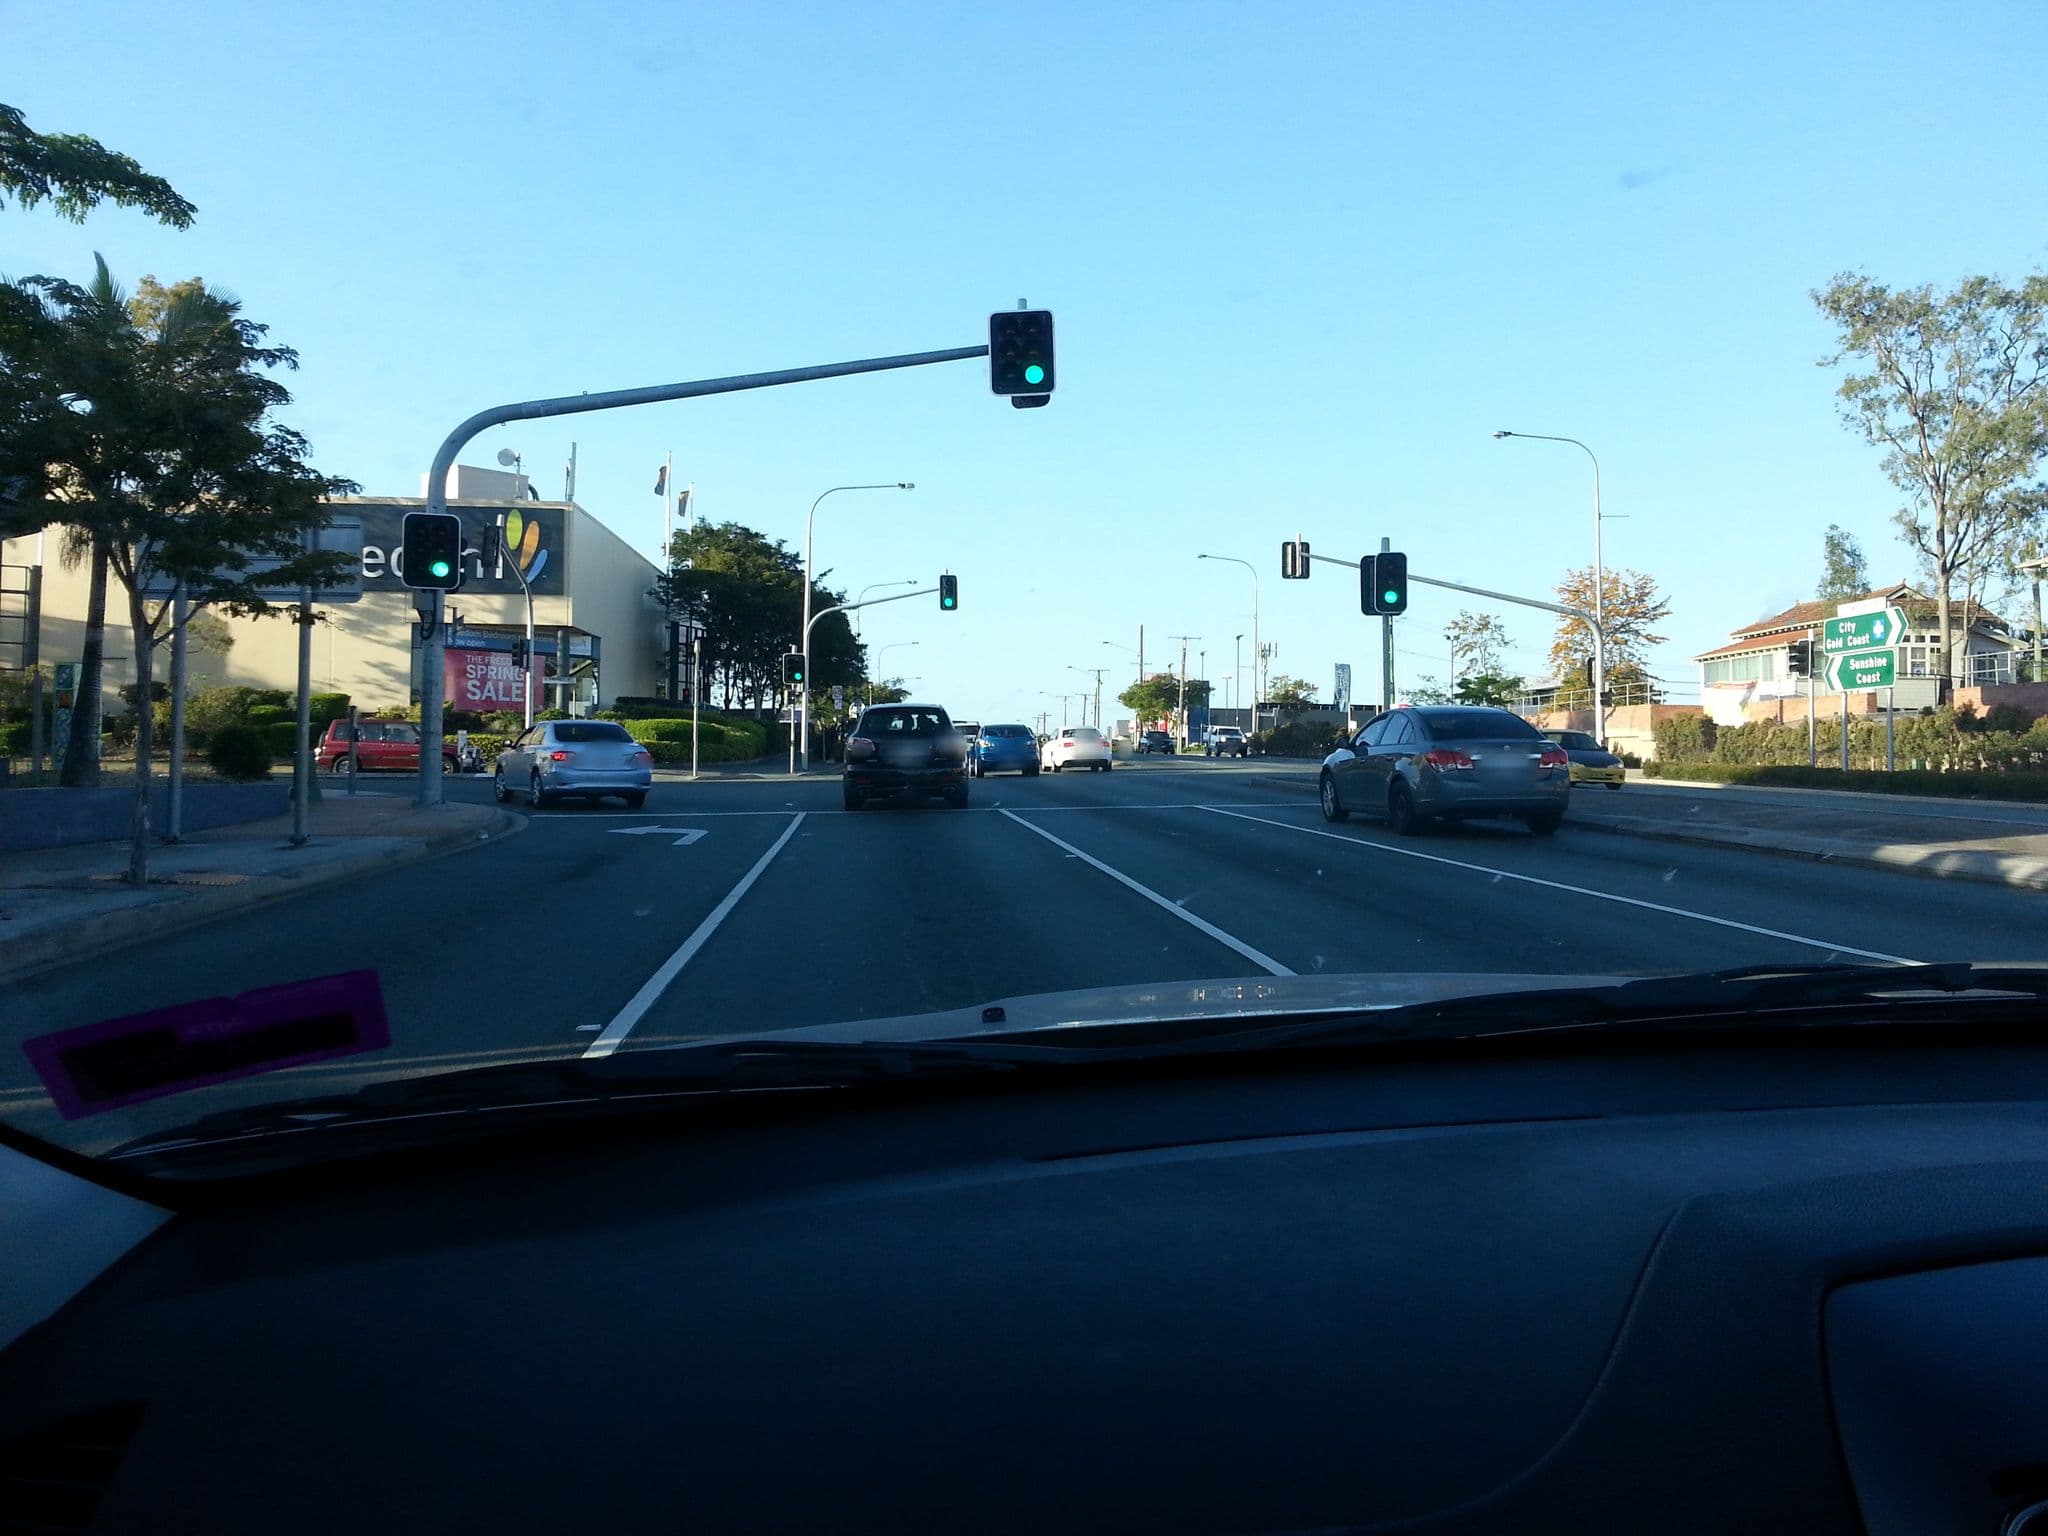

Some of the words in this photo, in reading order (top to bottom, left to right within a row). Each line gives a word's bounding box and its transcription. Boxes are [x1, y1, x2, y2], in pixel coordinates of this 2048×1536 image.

[1839, 622, 1856, 634] City
[1826, 637, 1843, 650] Gold
[1847, 633, 1870, 646] Coast
[466, 654, 484, 664] THE
[1849, 657, 1887, 671] Sunshine
[466, 664, 525, 682] SPRING
[1856, 671, 1881, 685] Coast
[466, 679, 525, 703] SALE
